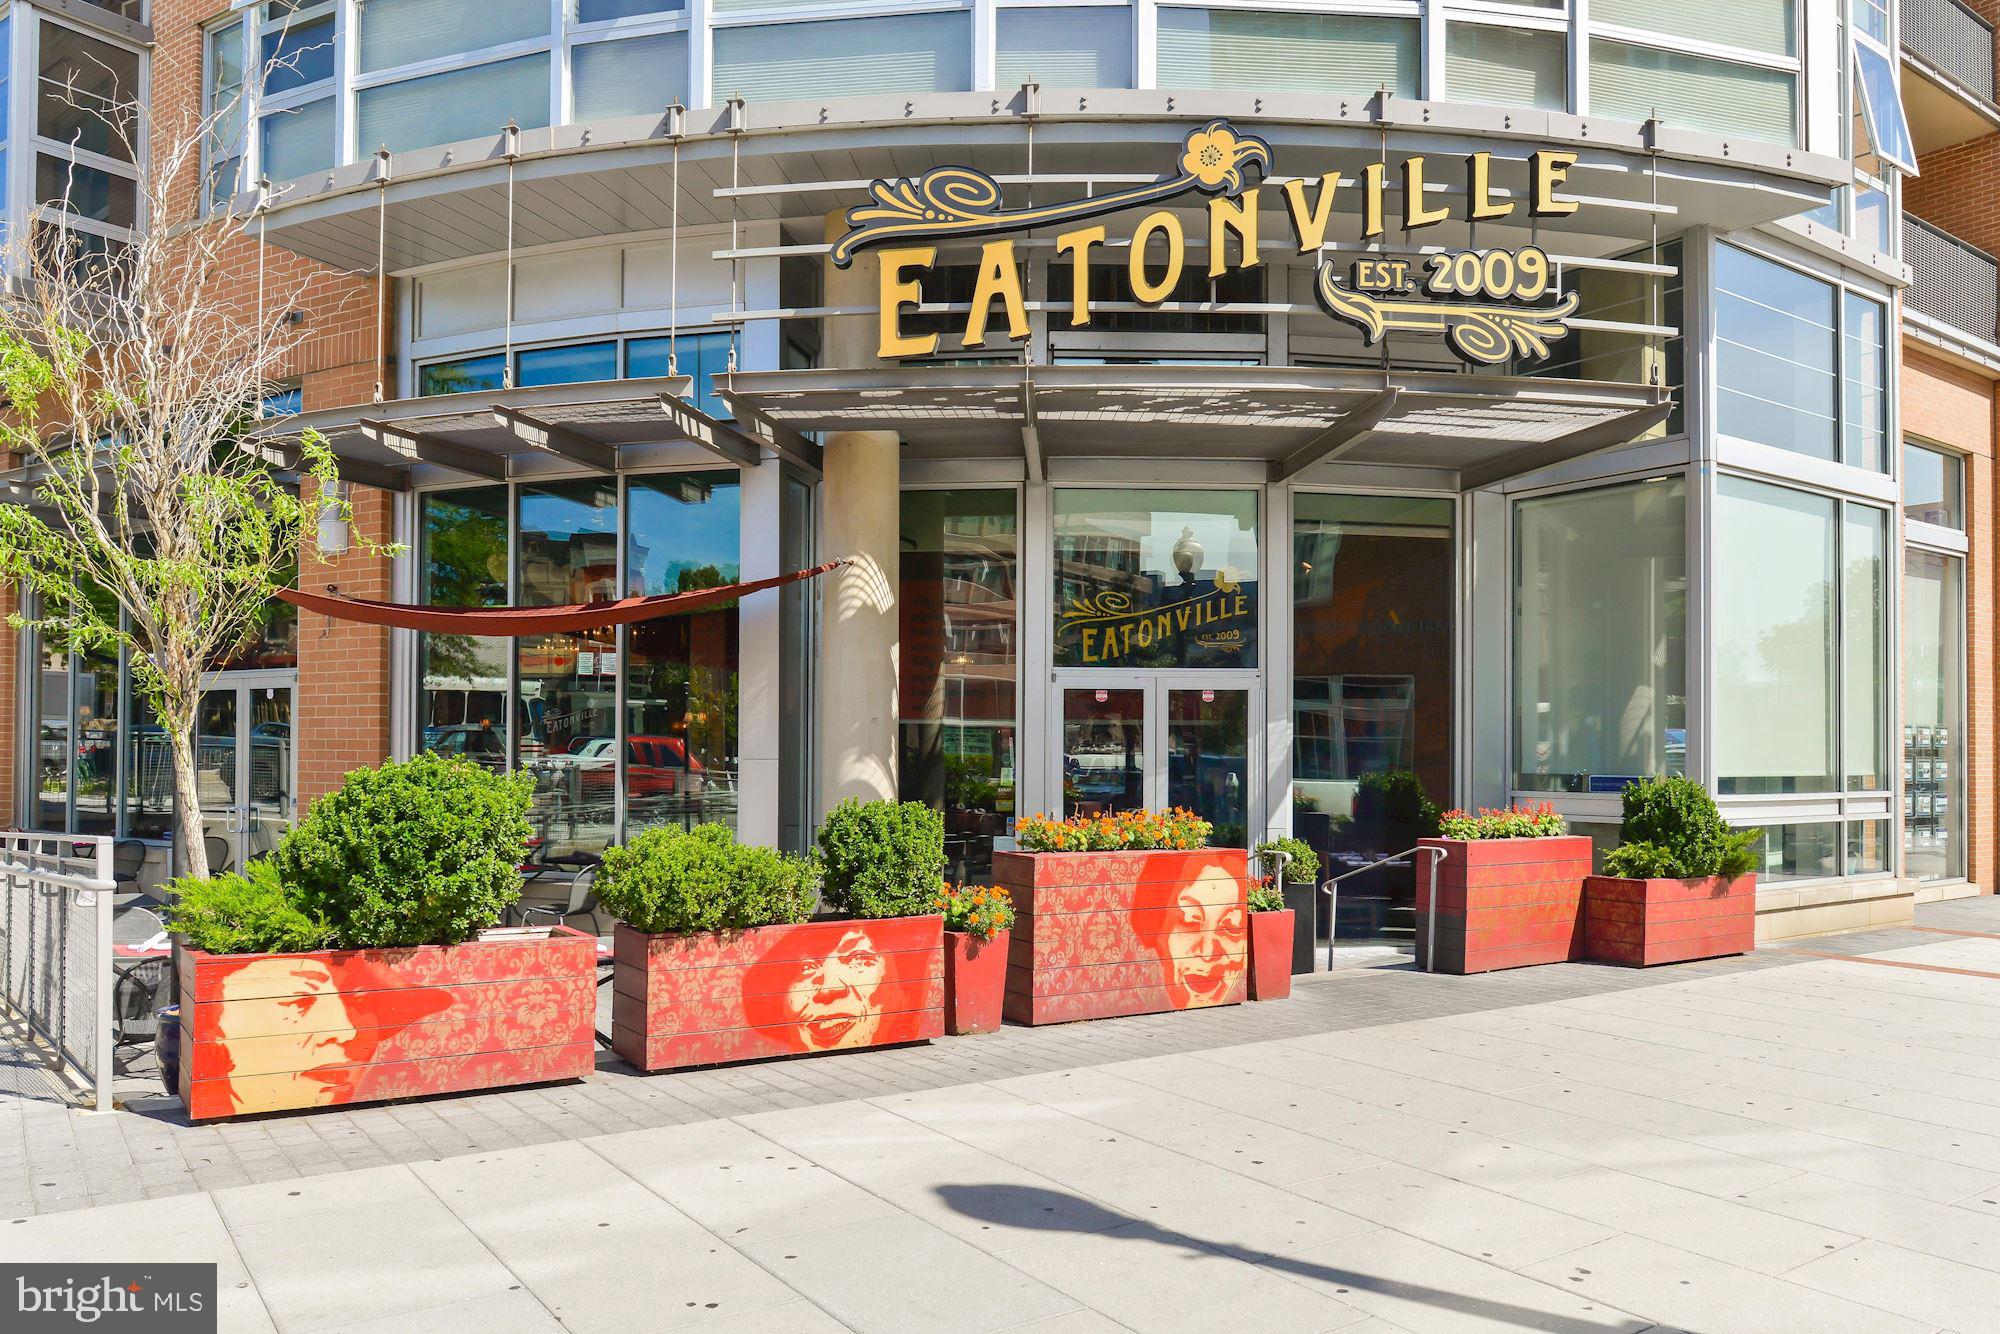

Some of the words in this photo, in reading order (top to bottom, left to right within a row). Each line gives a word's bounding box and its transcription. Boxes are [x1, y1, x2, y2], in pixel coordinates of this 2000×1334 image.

[877, 150, 1581, 359] EATONVILLE
[1359, 261, 1415, 290] EST.
[1432, 249, 1548, 298] 2009
[1082, 595, 1249, 662] EATONVILLE
[1215, 629, 1240, 640] 2009
